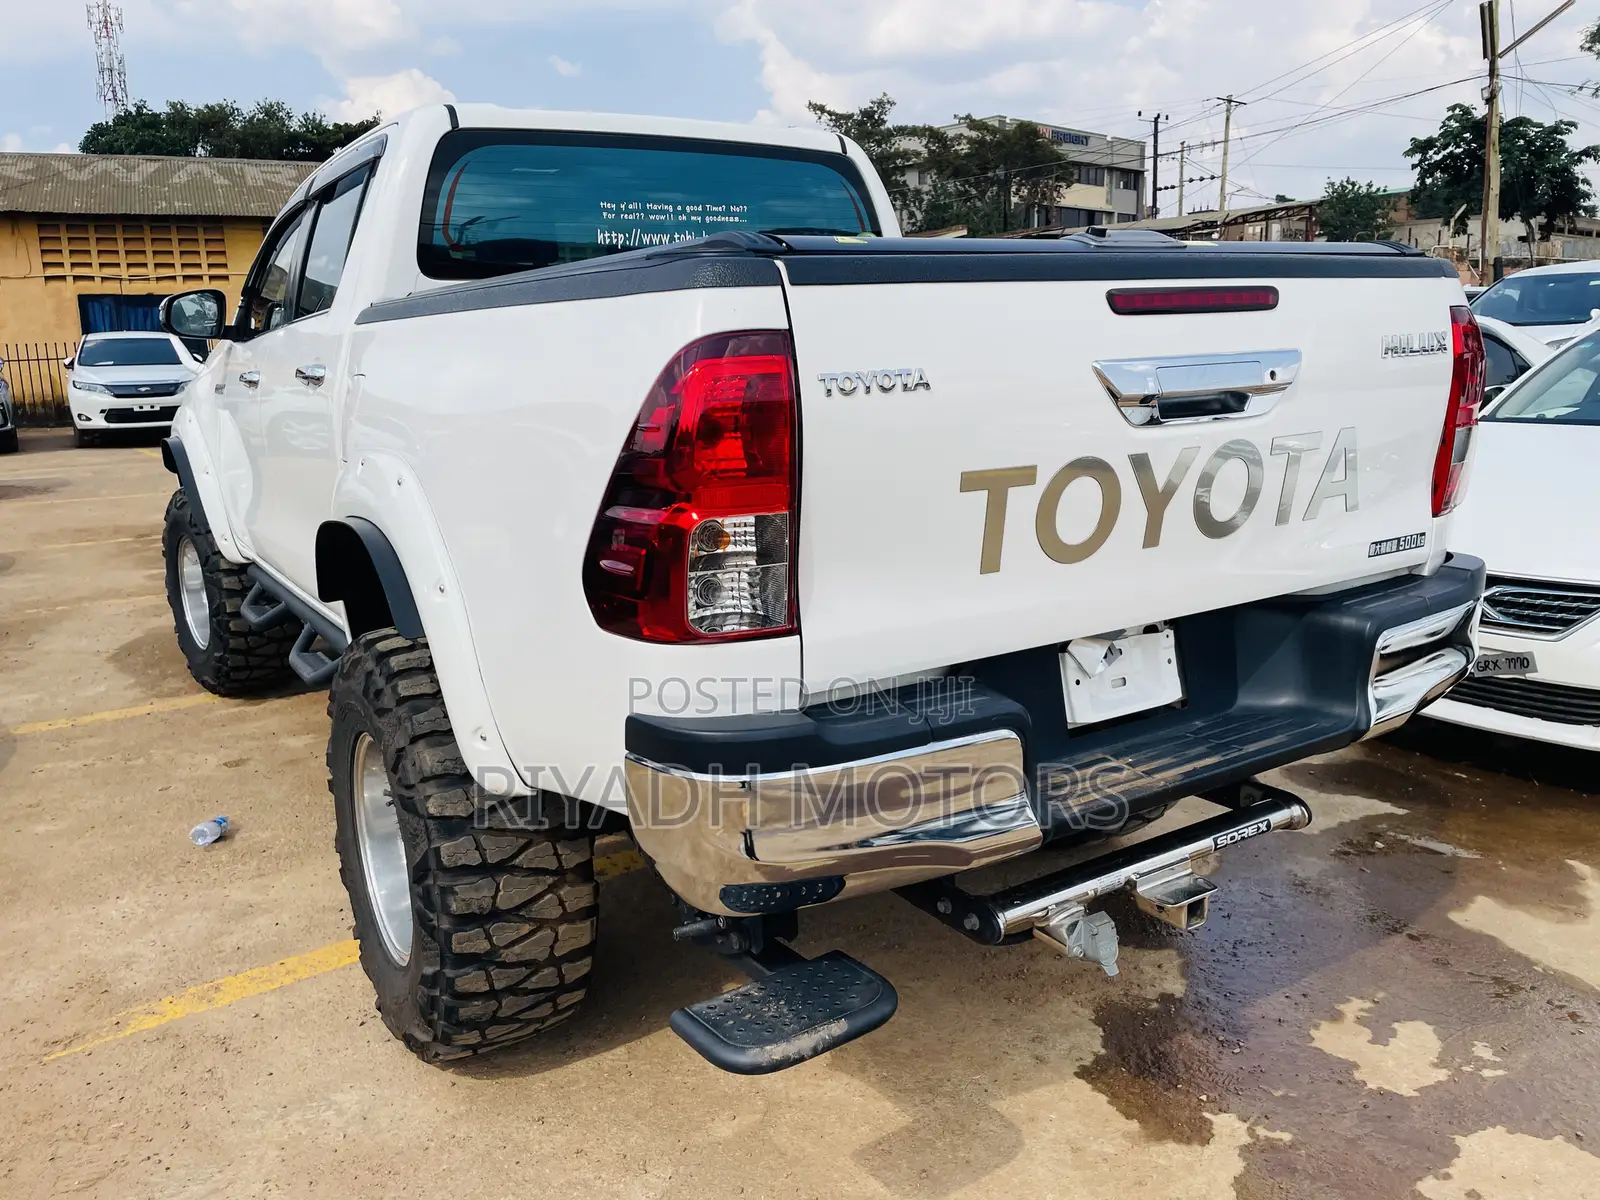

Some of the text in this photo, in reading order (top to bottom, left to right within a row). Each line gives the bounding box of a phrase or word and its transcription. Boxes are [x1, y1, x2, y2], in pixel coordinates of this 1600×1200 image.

[600, 201, 616, 211] Hey
[646, 202, 673, 212] Having
[685, 204, 702, 213] good
[705, 204, 726, 212] Time?
[730, 205, 747, 213] No??
[602, 211, 616, 219] For
[620, 212, 645, 220] real??
[678, 213, 687, 221] oh
[690, 214, 702, 223] my
[1380, 331, 1448, 359] HILUX
[817, 367, 932, 398] TOYOTA
[959, 426, 1360, 575] TOYOTA
[1476, 656, 1530, 672] GRX 7770
[1216, 820, 1269, 849] SOREX
